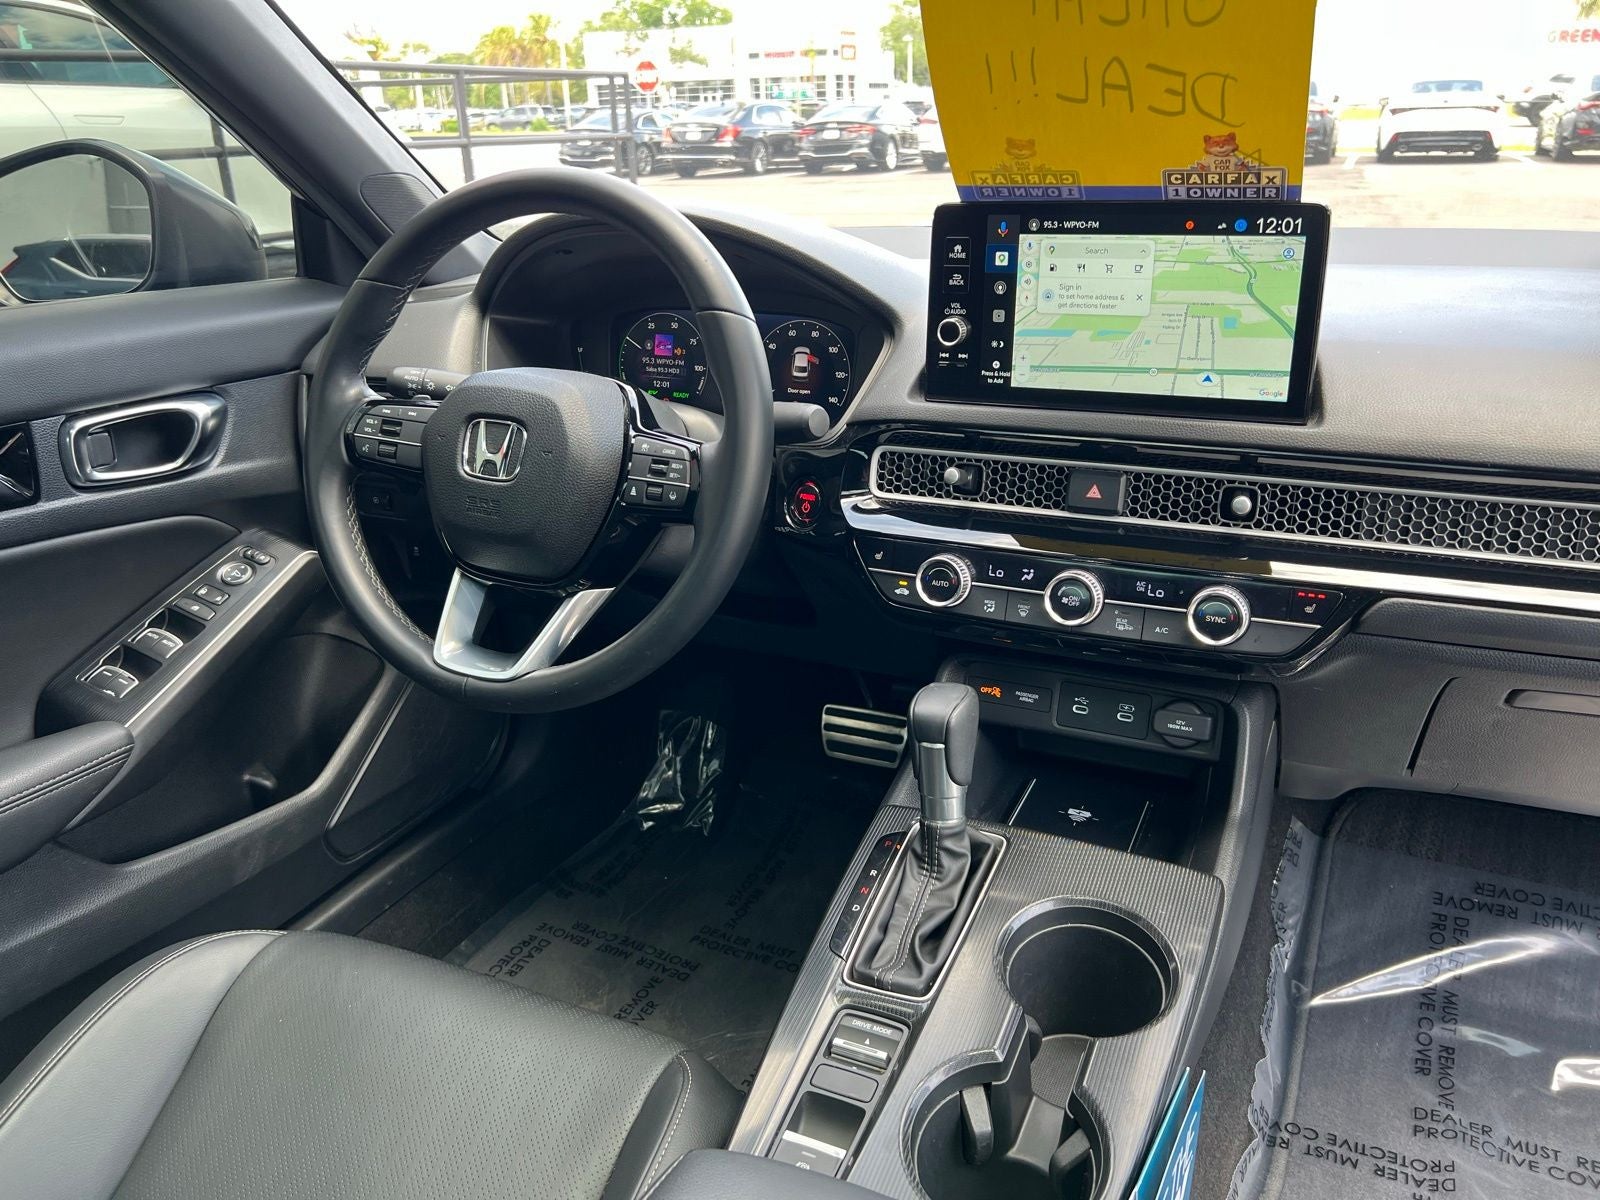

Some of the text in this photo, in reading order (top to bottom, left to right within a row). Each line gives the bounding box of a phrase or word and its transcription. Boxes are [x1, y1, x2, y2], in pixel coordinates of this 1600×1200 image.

[1170, 174, 1278, 184] CARFAX
[1172, 188, 1277, 198] 1 OWNER
[1043, 221, 1058, 229] 95.3
[1064, 221, 1099, 229] WPYO-FM
[1256, 217, 1303, 234] 12:01
[1084, 247, 1109, 255] Search
[1060, 283, 1074, 292] Sign
[788, 329, 797, 337] 60
[689, 338, 697, 346] 75
[828, 346, 839, 354] 100
[642, 357, 655, 365] 95.3
[835, 371, 846, 379] 120
[653, 380, 670, 388] 12:01
[1259, 388, 1284, 399] Google
[828, 396, 839, 404] 140
[931, 579, 950, 588] AUTO
[1205, 615, 1227, 625] SYNC
[1154, 626, 1169, 634] A/C
[980, 686, 993, 694] OFF
[1015, 690, 1039, 700] PASSENGER
[869, 869, 878, 877] R
[860, 887, 870, 895] N
[1474, 881, 1546, 906] COVER
[851, 904, 860, 912] D
[1432, 891, 1518, 920] REMOVE
[1531, 911, 1583, 935] MUST
[536, 921, 593, 948] REMOVE
[504, 937, 552, 978] DEALER
[613, 975, 664, 1021] REMOVE
[1441, 989, 1460, 1036] MUST
[851, 1019, 893, 1035] DRIVE MODE
[1414, 1016, 1435, 1077] COVER
[1438, 1044, 1456, 1112] REMOVE
[1413, 1106, 1600, 1175] DEALER MUST RE
[1303, 1144, 1359, 1170] MUST
[1326, 1132, 1456, 1173] PROTECTIVE
[1413, 1124, 1600, 1189] PROTECTIVE COV
[1373, 1163, 1456, 1192] DEALER
